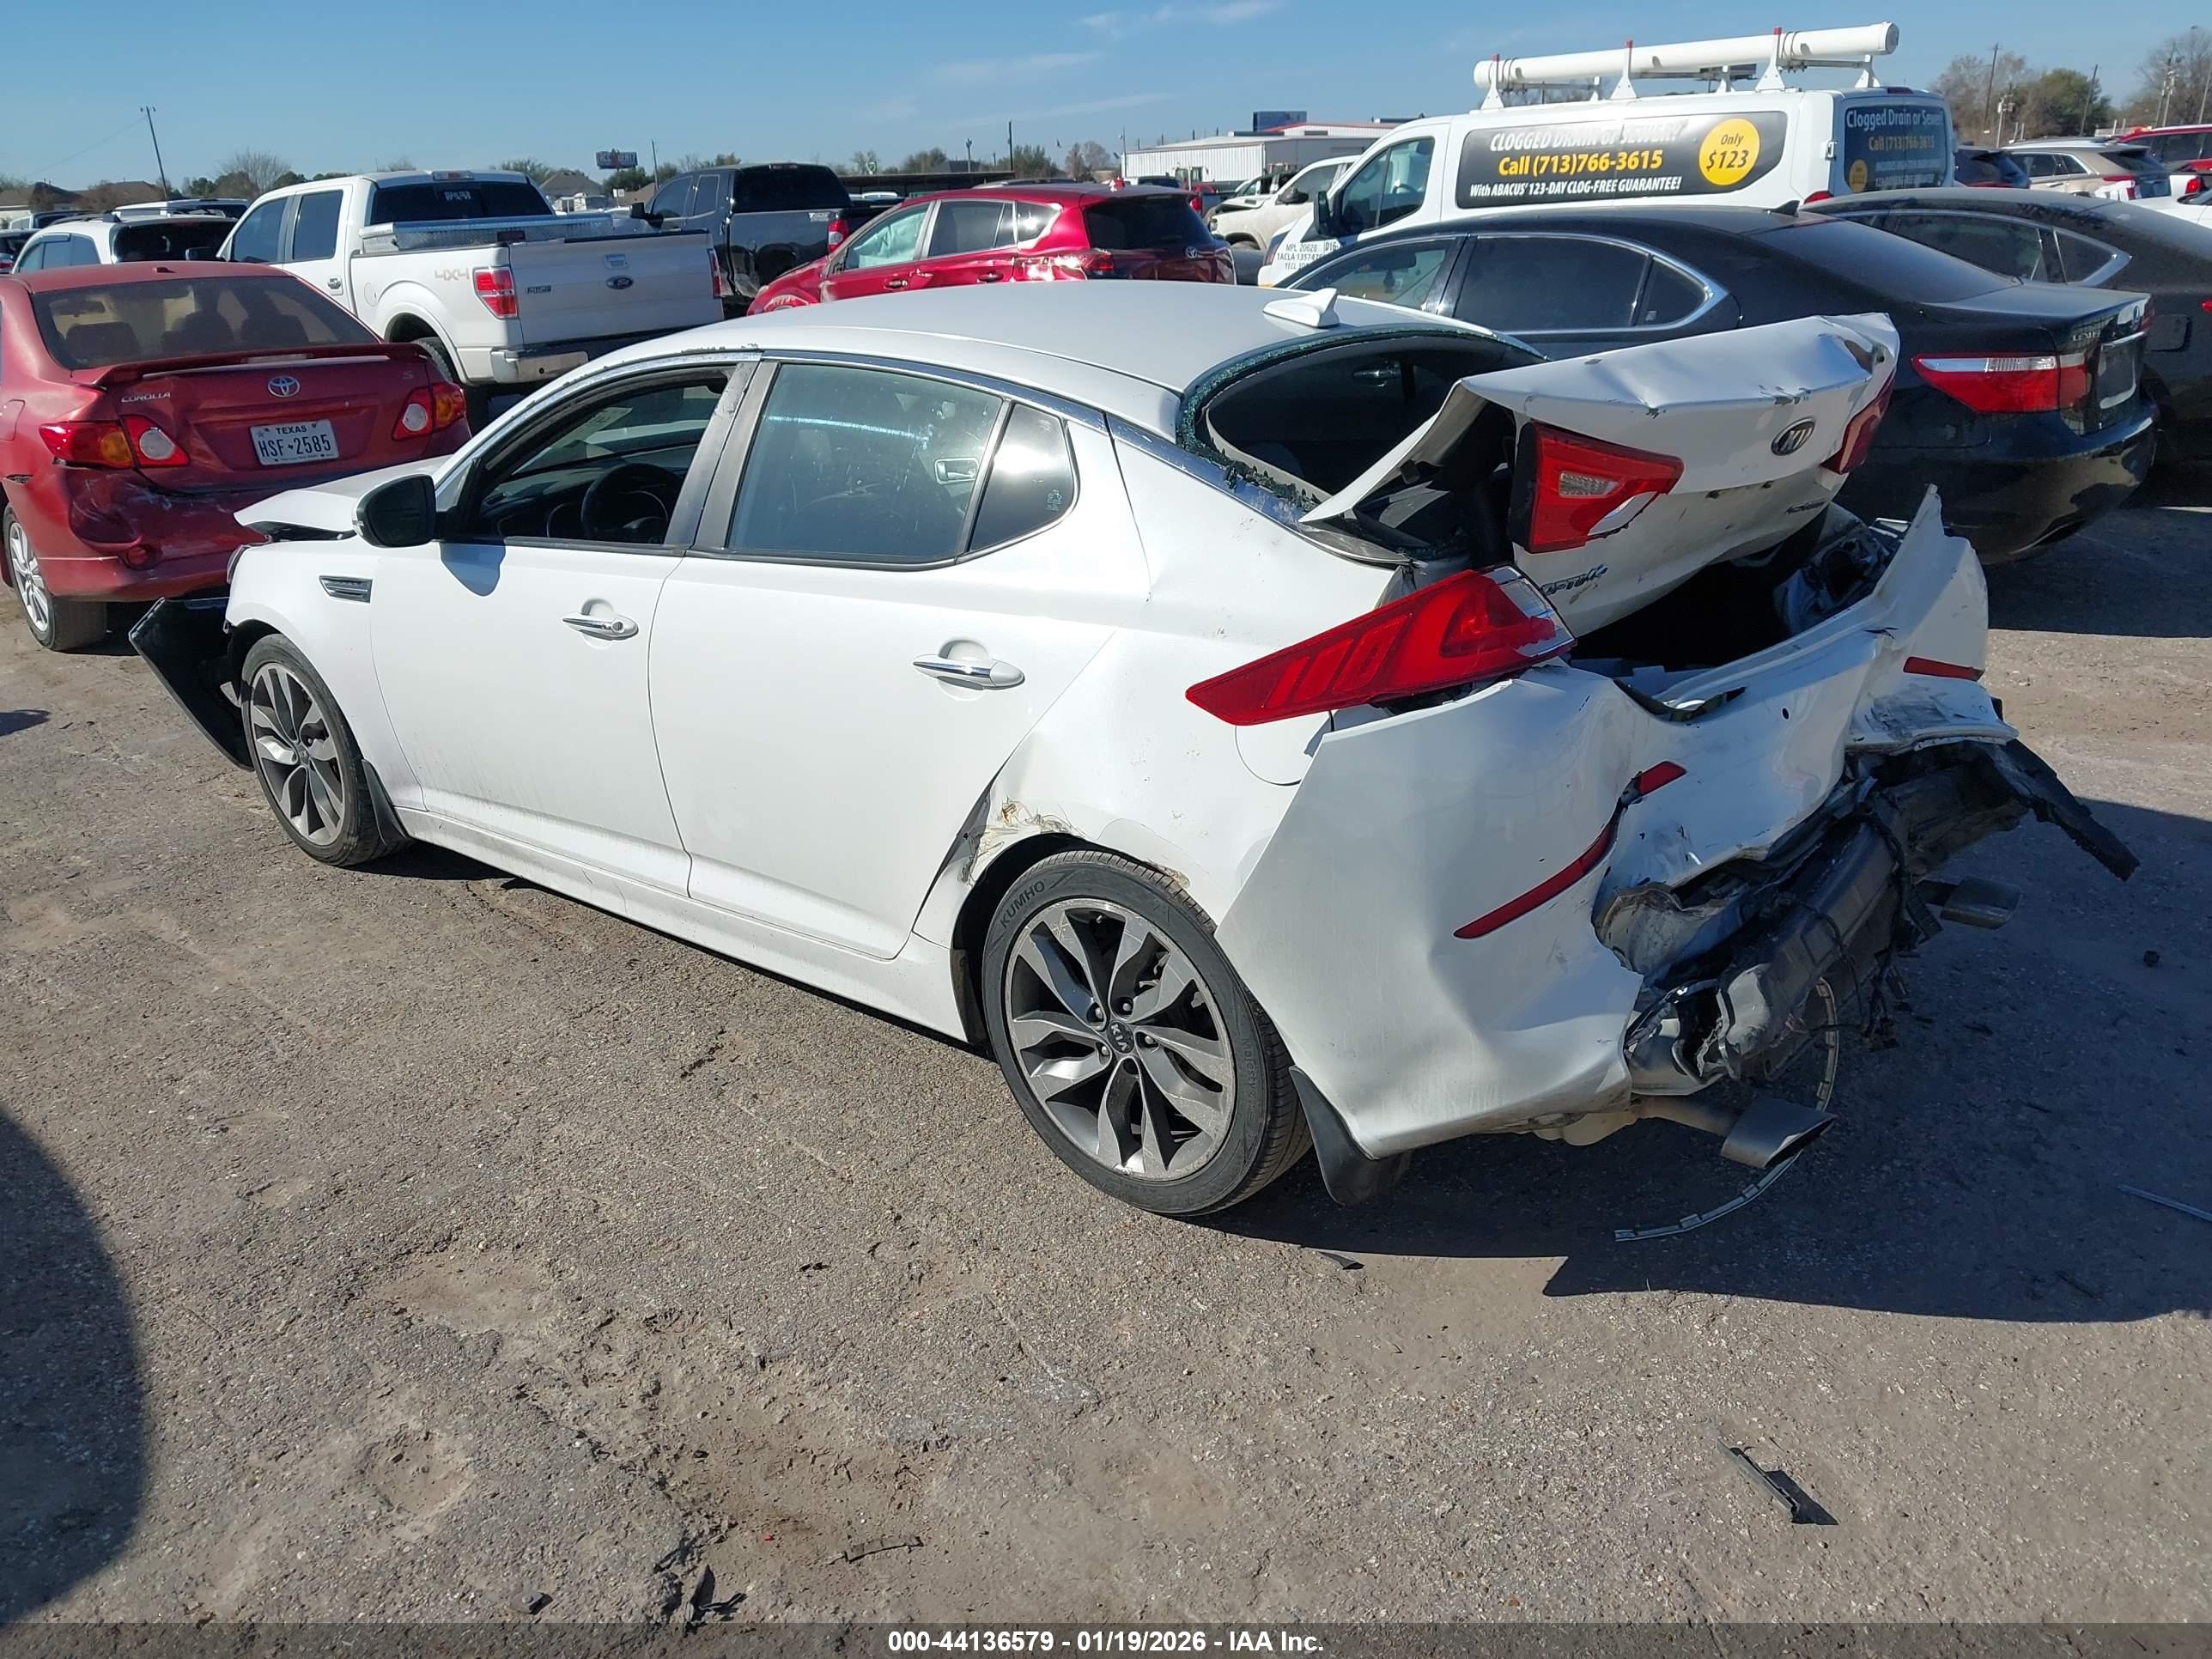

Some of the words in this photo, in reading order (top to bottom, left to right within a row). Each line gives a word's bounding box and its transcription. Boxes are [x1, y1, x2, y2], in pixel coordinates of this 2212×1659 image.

[1846, 109, 1887, 131] Clogged
[1888, 108, 1911, 125] Drain
[1911, 112, 1922, 125] or
[1491, 131, 1552, 151] CLOGGED
[1720, 132, 1745, 147] Only
[1869, 137, 1884, 151] Call
[1498, 155, 1531, 176] Call
[1533, 149, 1663, 177] (713)766-3615
[1705, 149, 1749, 172] $123
[1470, 184, 1492, 197] With
[1528, 181, 1567, 195] 123-DAY
[1566, 179, 1618, 194] CLOG-FREE
[1618, 172, 1683, 191] GUARANTEE!
[121, 392, 171, 403] COROLLA
[276, 425, 307, 434] TEXAS
[1000, 880, 1045, 928] KUMHO
